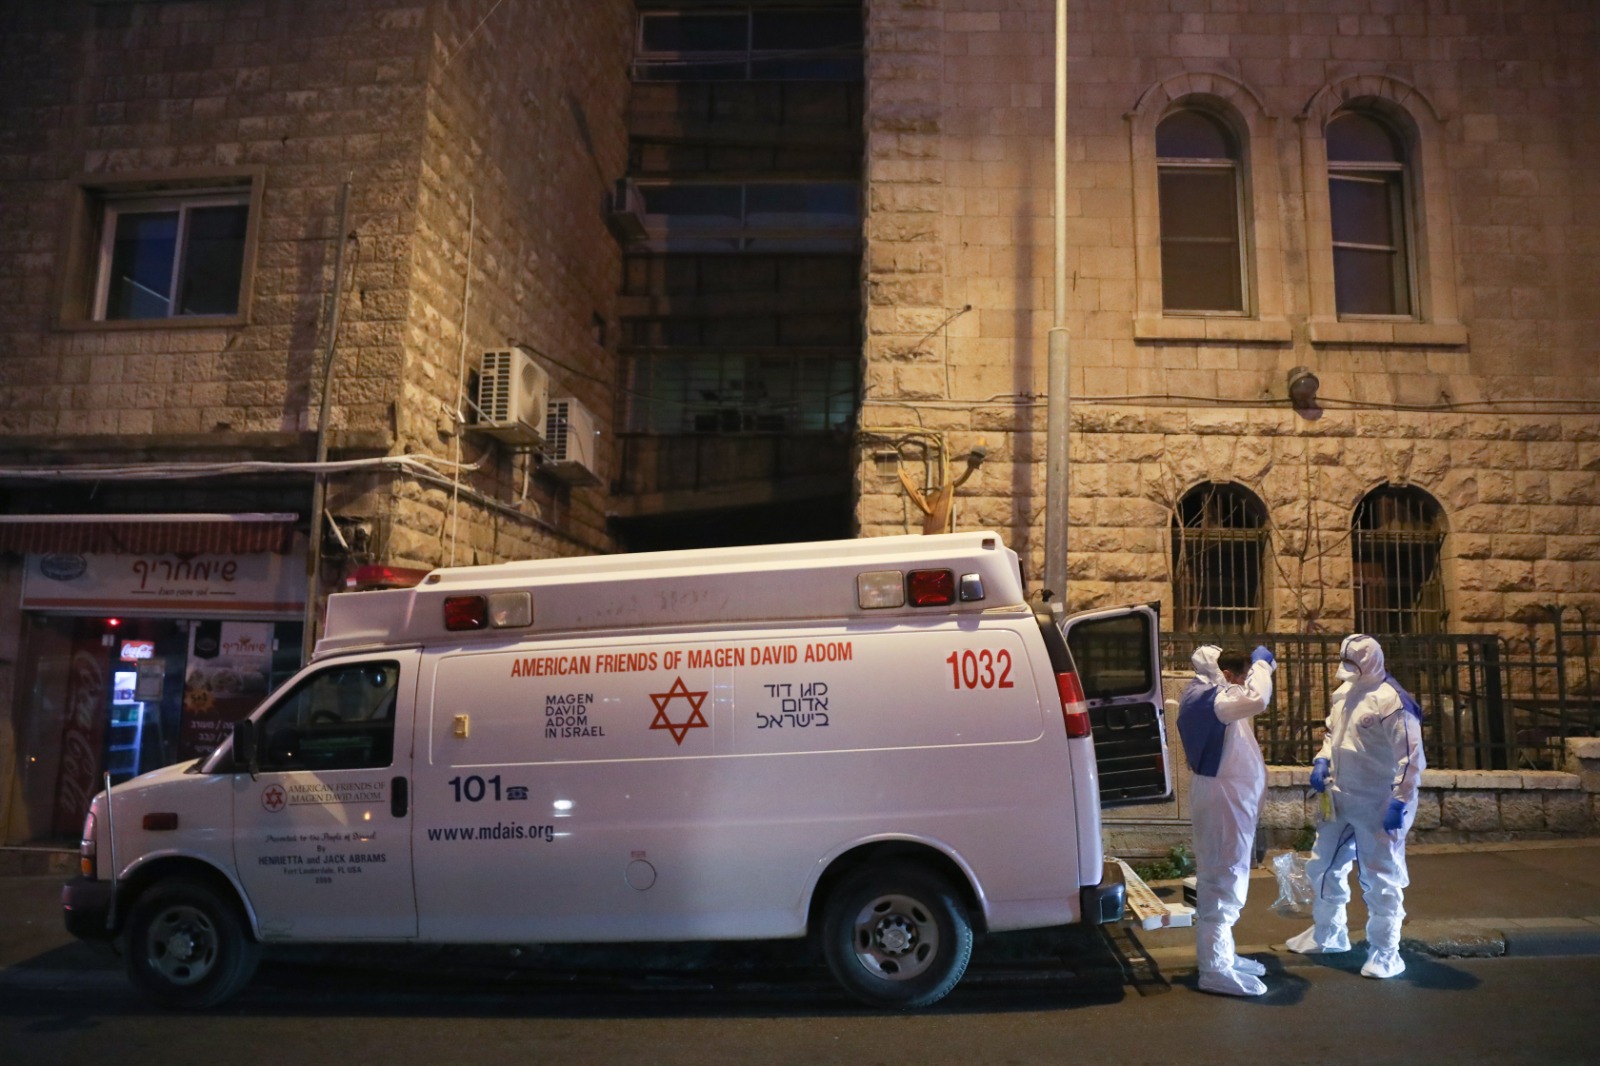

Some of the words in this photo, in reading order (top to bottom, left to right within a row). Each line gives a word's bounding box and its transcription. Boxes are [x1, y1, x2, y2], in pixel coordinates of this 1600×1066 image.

[511, 655, 591, 678] AMERICAN
[595, 652, 658, 674] FRIENDS
[663, 650, 682, 670] OF
[687, 647, 745, 669] MAGEN
[750, 644, 798, 666] DAVID
[804, 641, 853, 663] ADOM
[946, 648, 1014, 690] 1032
[764, 683, 792, 698] דוד
[800, 682, 828, 698] מגן
[546, 693, 594, 705] MAGEN
[782, 697, 829, 713] אדום
[545, 704, 586, 717] DAVID
[546, 715, 588, 728] ADOM
[757, 712, 830, 729] בישראל
[545, 727, 557, 739] IN
[561, 726, 606, 738] ISRAEL
[289, 783, 334, 793] AMERICAN
[336, 782, 372, 792] FRIENDS
[373, 781, 385, 790] OF
[448, 774, 502, 803] 101
[291, 793, 324, 802] MAGEN
[325, 792, 352, 801] DAVID
[354, 791, 382, 800] ADOM
[428, 821, 555, 843] www.mdais.org
[316, 844, 326, 853] By
[258, 855, 304, 865] HENRIETTA
[307, 855, 321, 864] and
[323, 854, 346, 864] JACK
[348, 853, 386, 863] ABRAMS
[347, 866, 362, 874] USA
